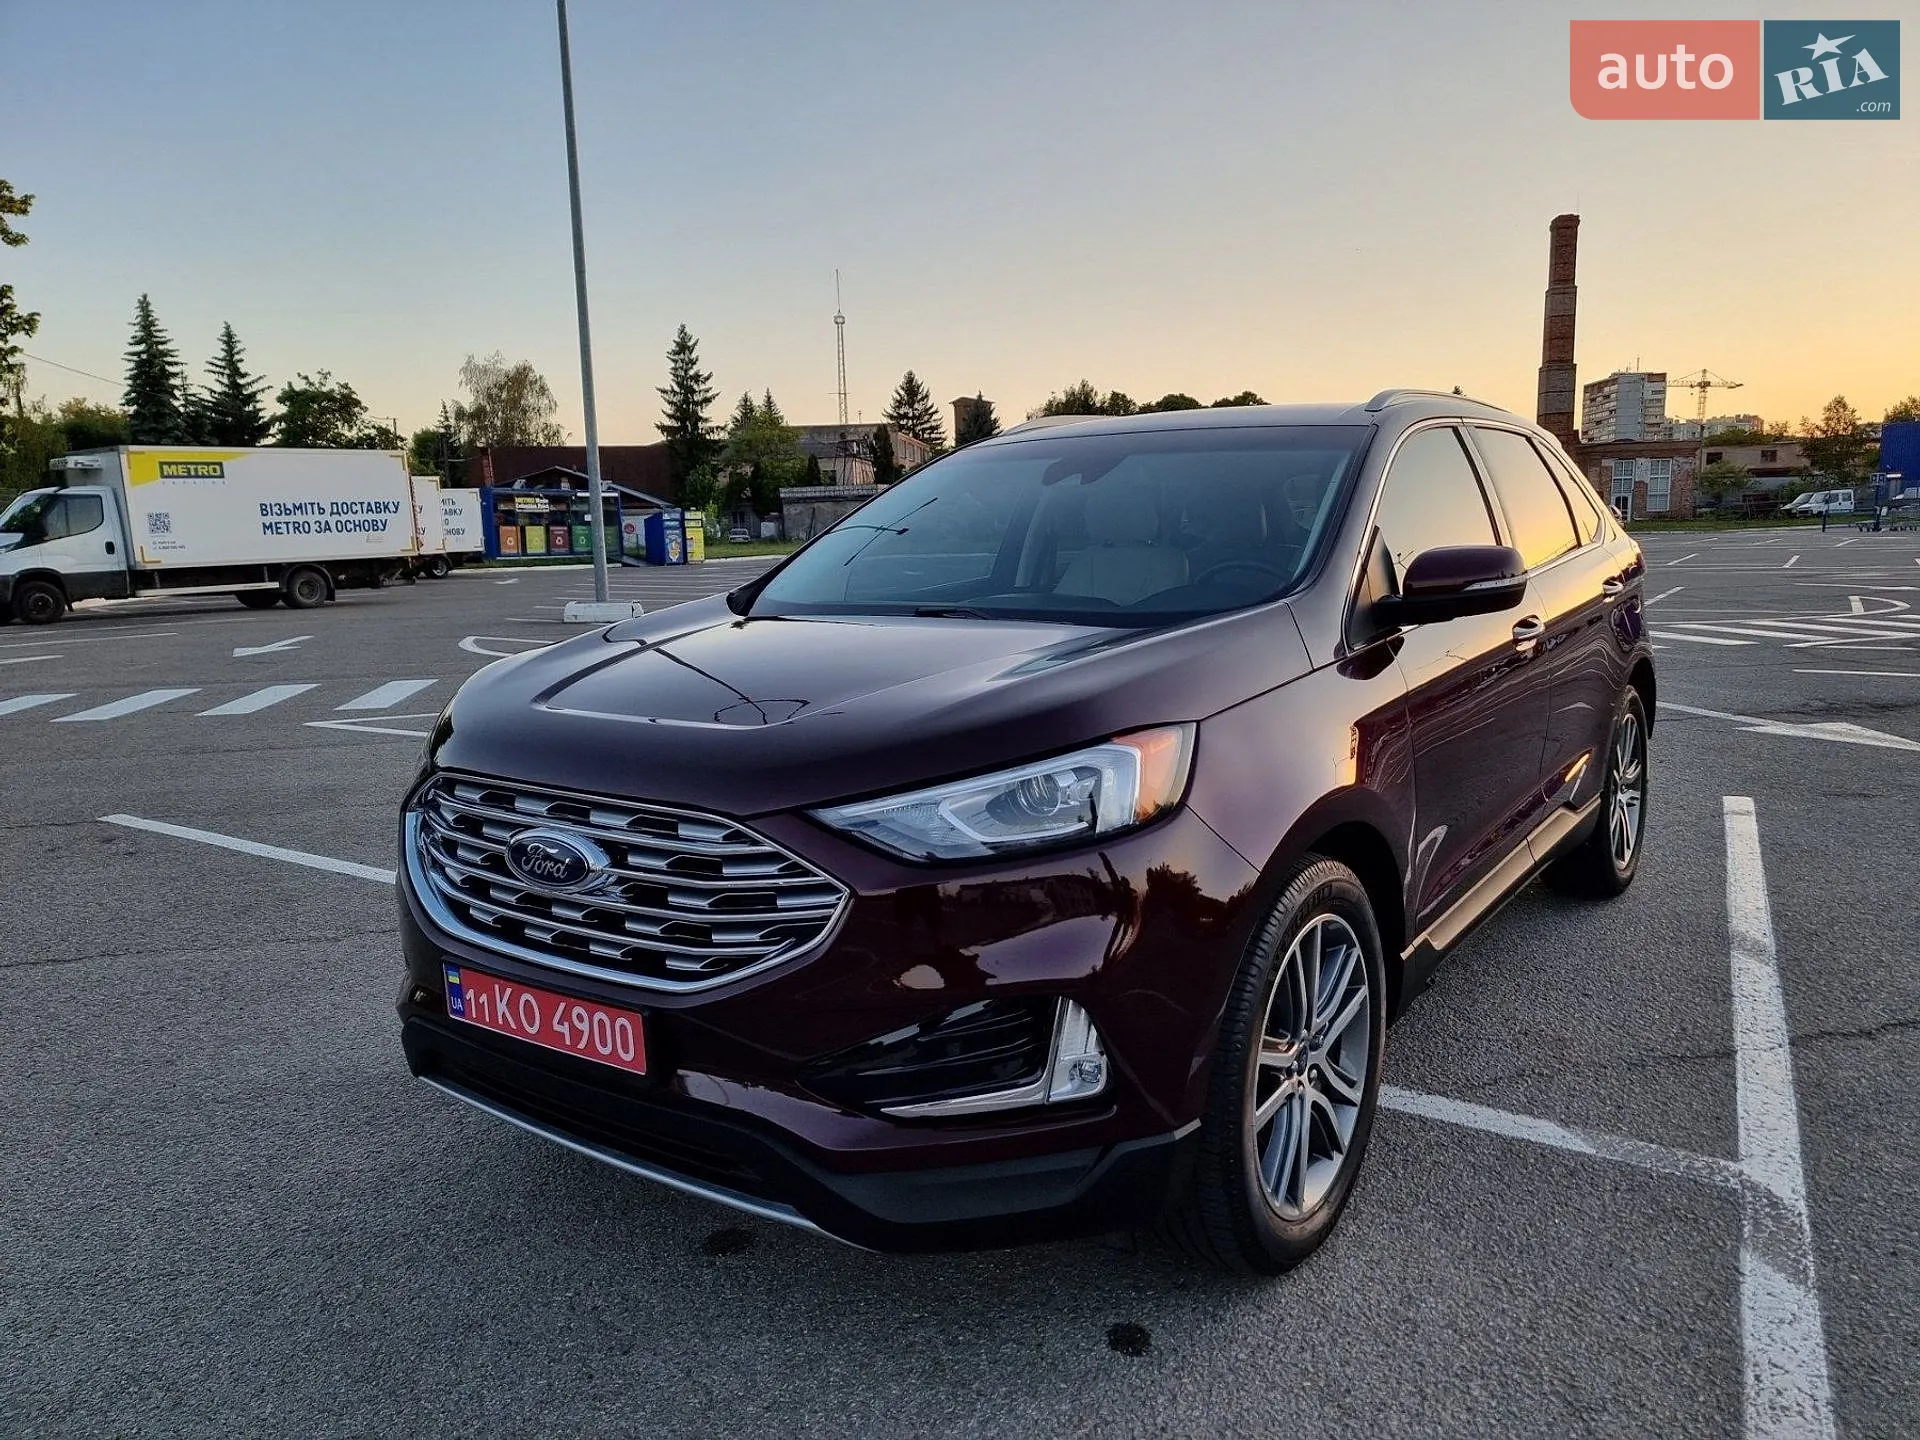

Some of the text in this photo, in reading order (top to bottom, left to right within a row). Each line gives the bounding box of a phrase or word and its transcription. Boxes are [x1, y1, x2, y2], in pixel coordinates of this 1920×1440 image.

[162, 464, 221, 476] METRO
[259, 502, 326, 517] ВІЗЬМІТЬ
[329, 501, 400, 517] ДОСТАВКУ
[262, 519, 388, 536] METRO ЗА ОСНОВУ
[521, 842, 569, 879] Ford
[451, 996, 464, 1012] UA
[552, 1002, 636, 1062] 4900
